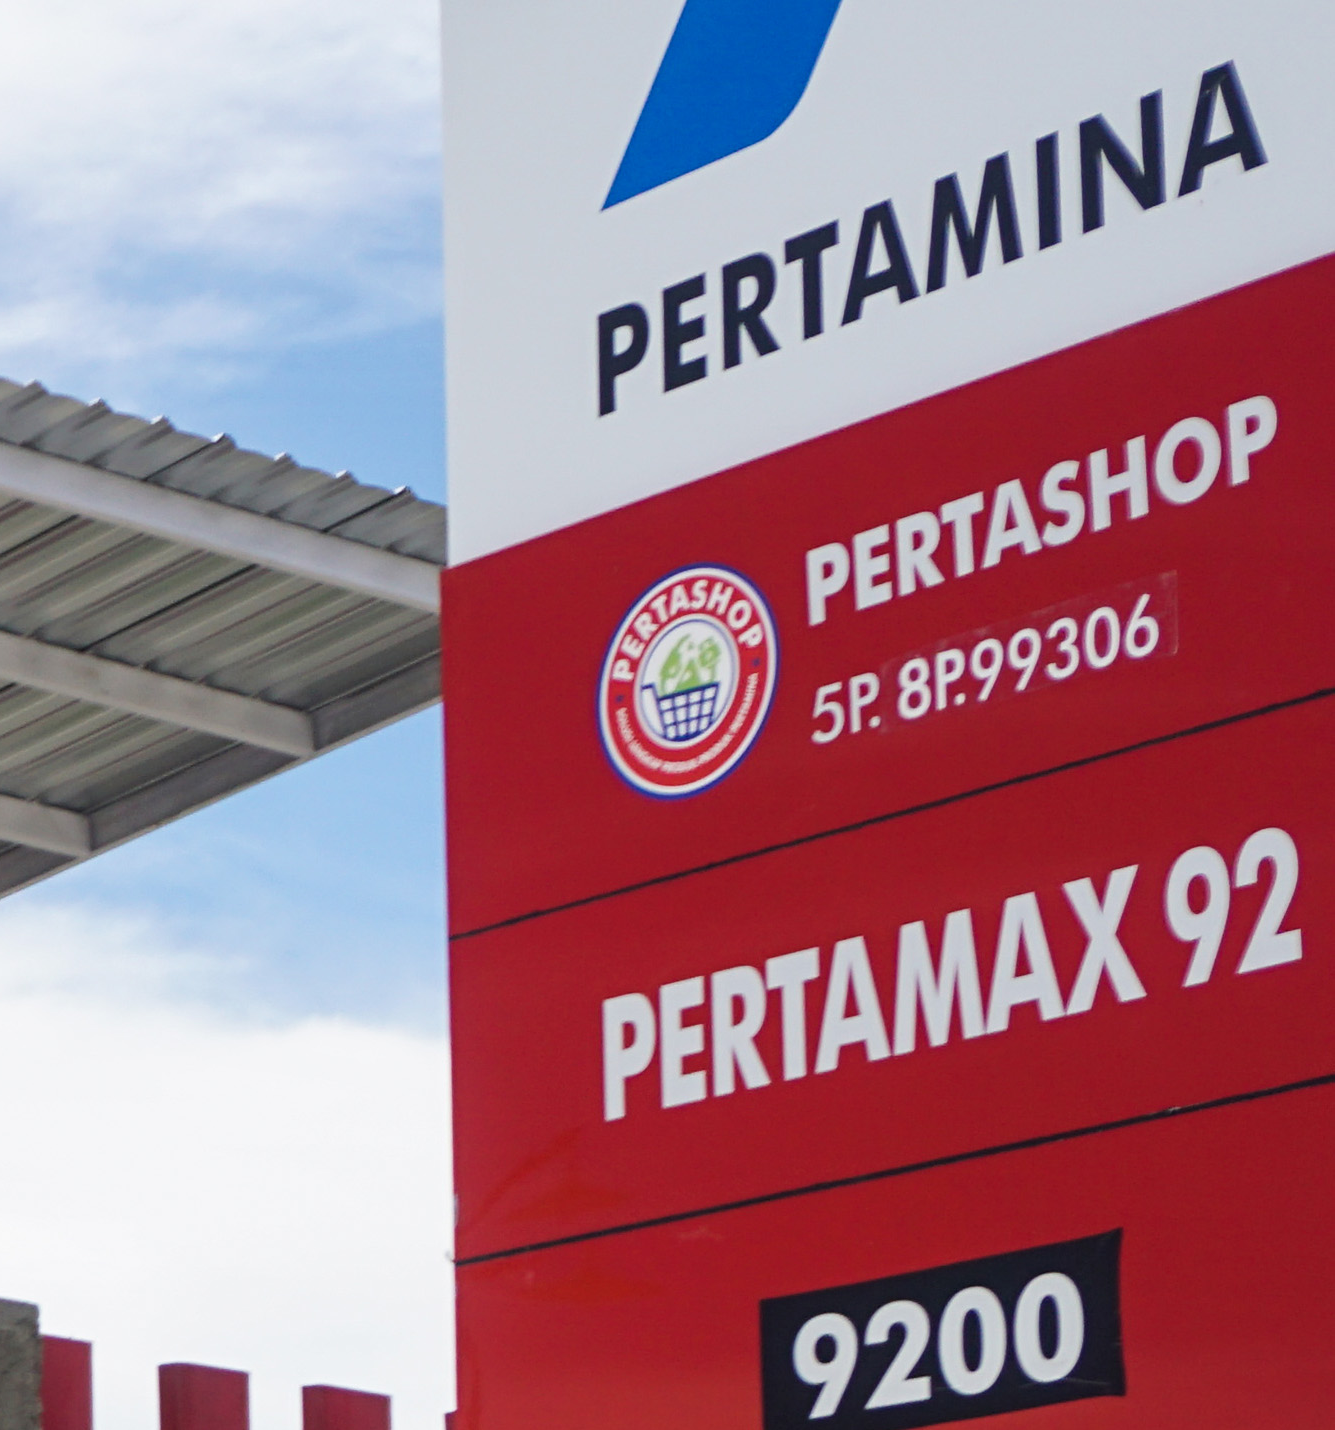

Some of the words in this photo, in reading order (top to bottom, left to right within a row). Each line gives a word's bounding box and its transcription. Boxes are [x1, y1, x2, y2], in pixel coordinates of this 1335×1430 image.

[596, 58, 1270, 418] PERTAMINA
[804, 394, 1279, 628] PERTASHOP
[611, 578, 764, 683] PERTASHOP
[810, 671, 882, 744] 5P.
[896, 593, 1161, 720] 8P.99306
[601, 864, 1148, 1123] PERTAMAX
[1164, 826, 1304, 989] 92
[791, 1271, 1086, 1420] 9200
